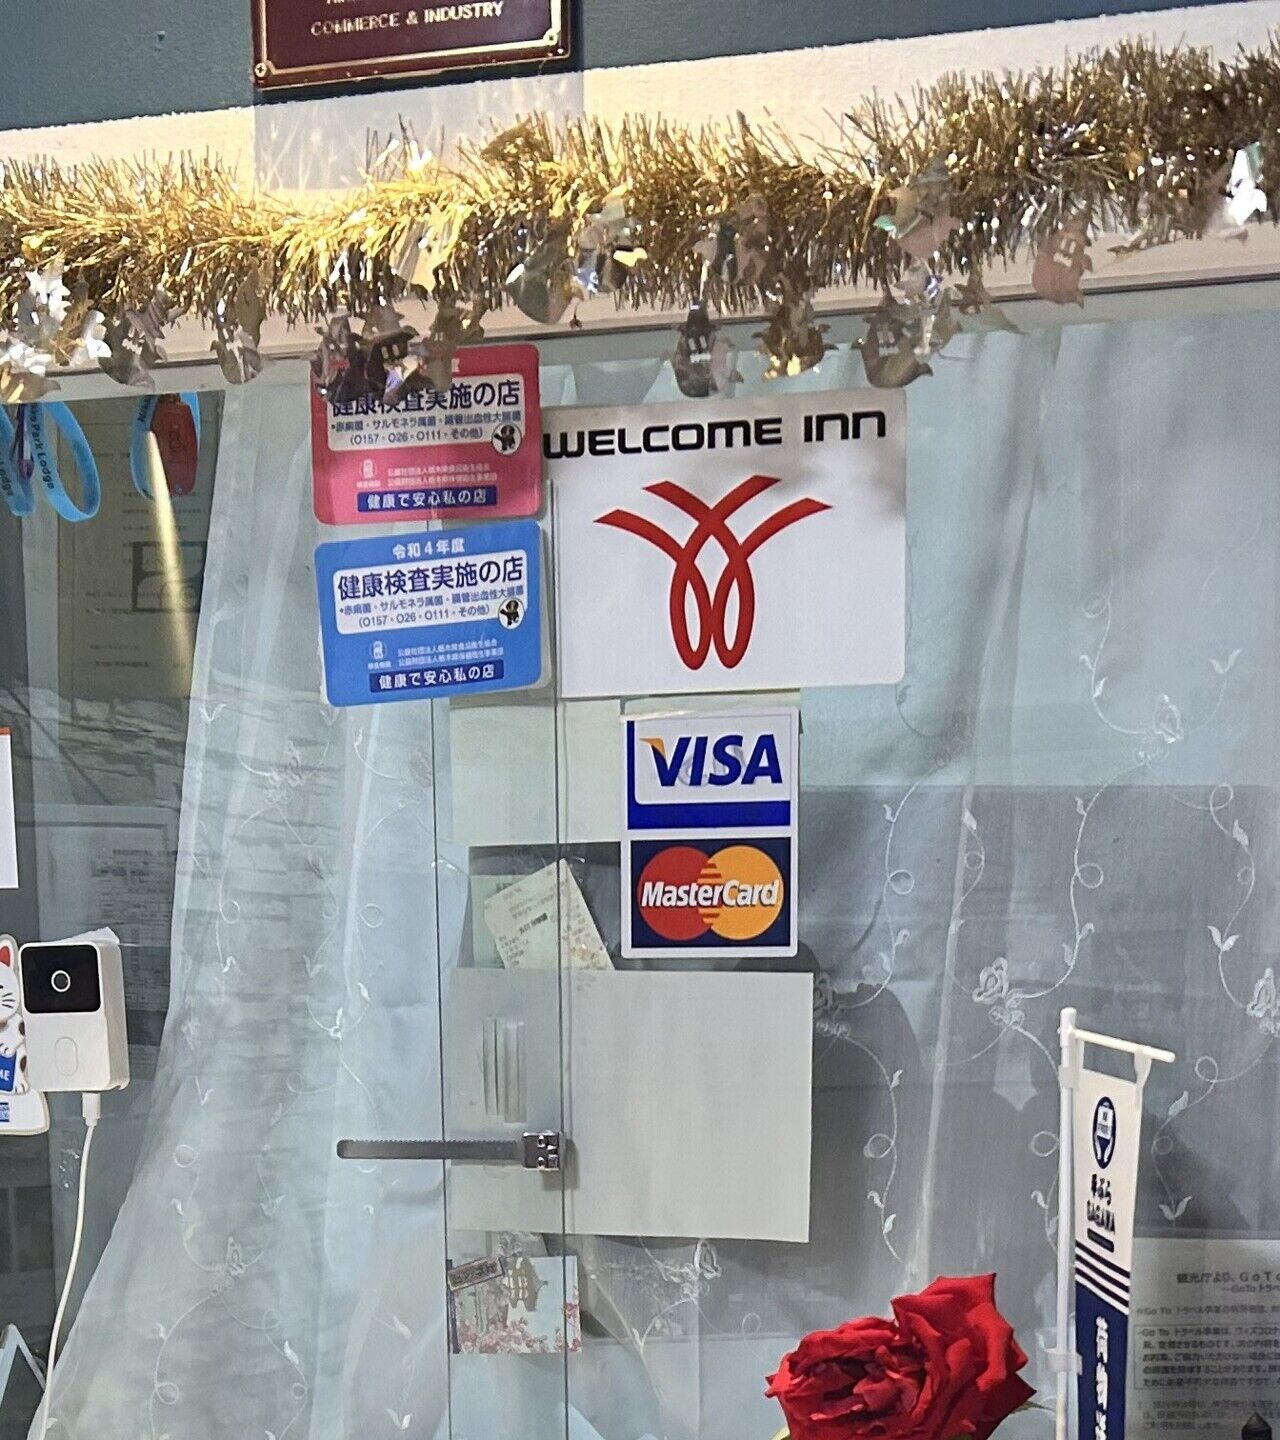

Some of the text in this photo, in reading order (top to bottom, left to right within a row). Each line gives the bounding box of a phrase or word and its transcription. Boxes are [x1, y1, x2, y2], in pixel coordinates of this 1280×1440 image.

[310, 1, 504, 36] COMMERCE & INDUSTRY
[31, 423, 44, 451] Park
[543, 410, 886, 459] WELCOME INN
[37, 452, 55, 490] Lodge
[367, 488, 487, 510] 健康で安心私の店
[337, 556, 524, 601] 健康検査実施の店
[379, 664, 496, 690] 健康で安心私の店
[640, 733, 783, 787] VISA
[640, 878, 781, 909] MasterCard
